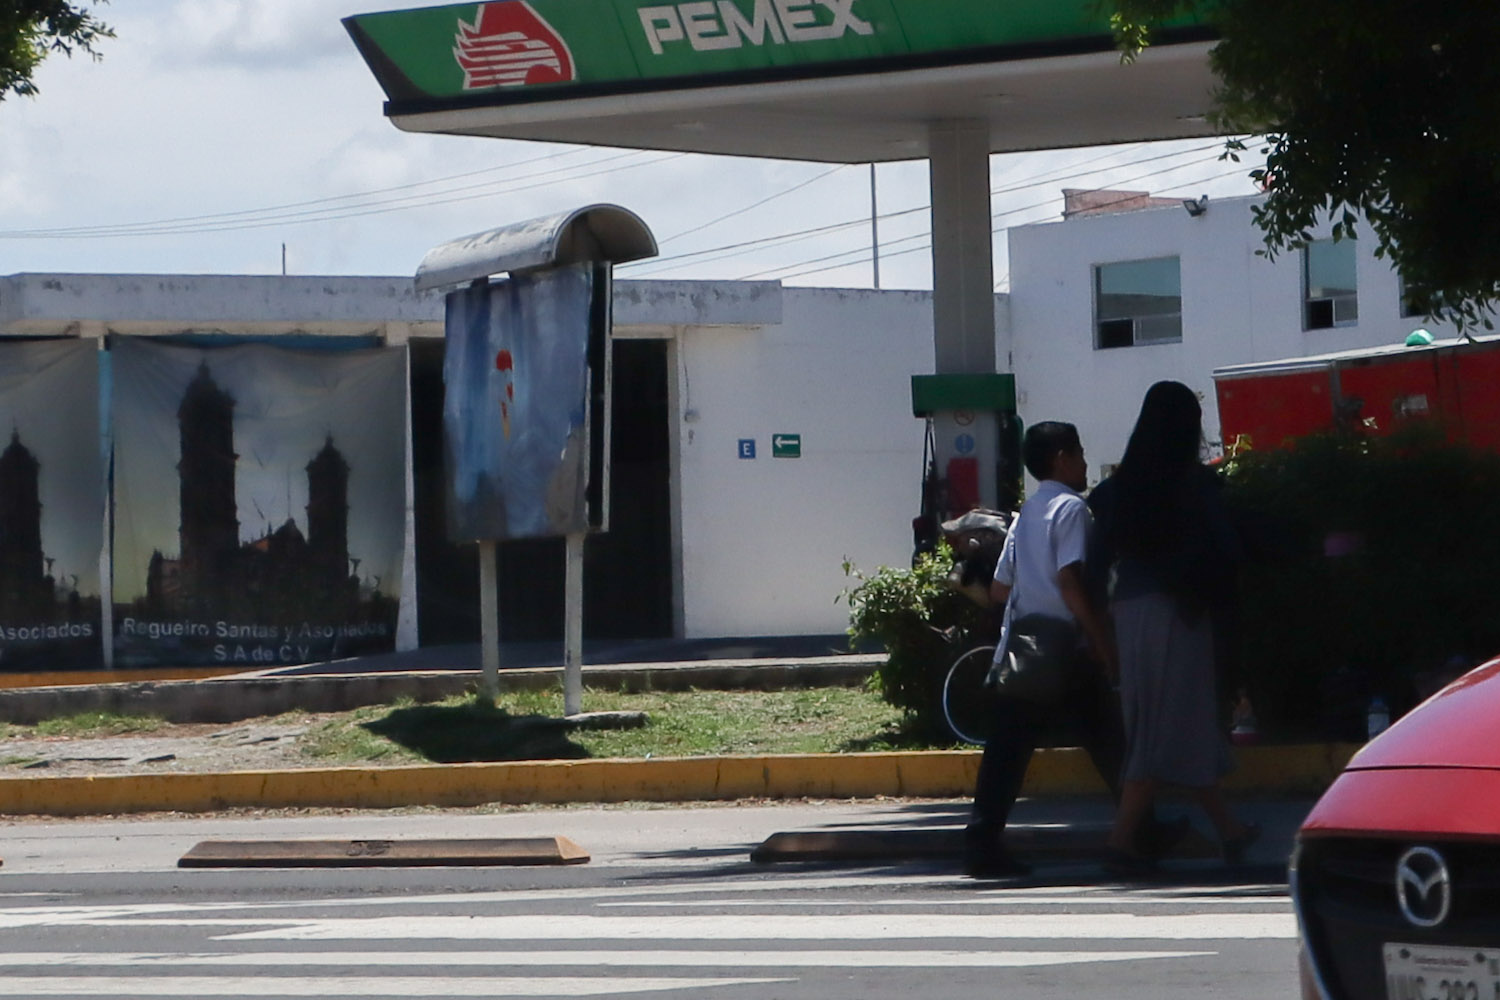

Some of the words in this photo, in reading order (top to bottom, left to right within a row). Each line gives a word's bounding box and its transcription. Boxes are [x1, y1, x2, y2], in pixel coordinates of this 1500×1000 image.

[637, 0, 874, 54] PEMEX
[743, 442, 751, 456] E
[124, 618, 209, 640] Regueiro
[216, 621, 278, 639] Santas
[285, 625, 294, 642] y
[251, 645, 274, 662] de
